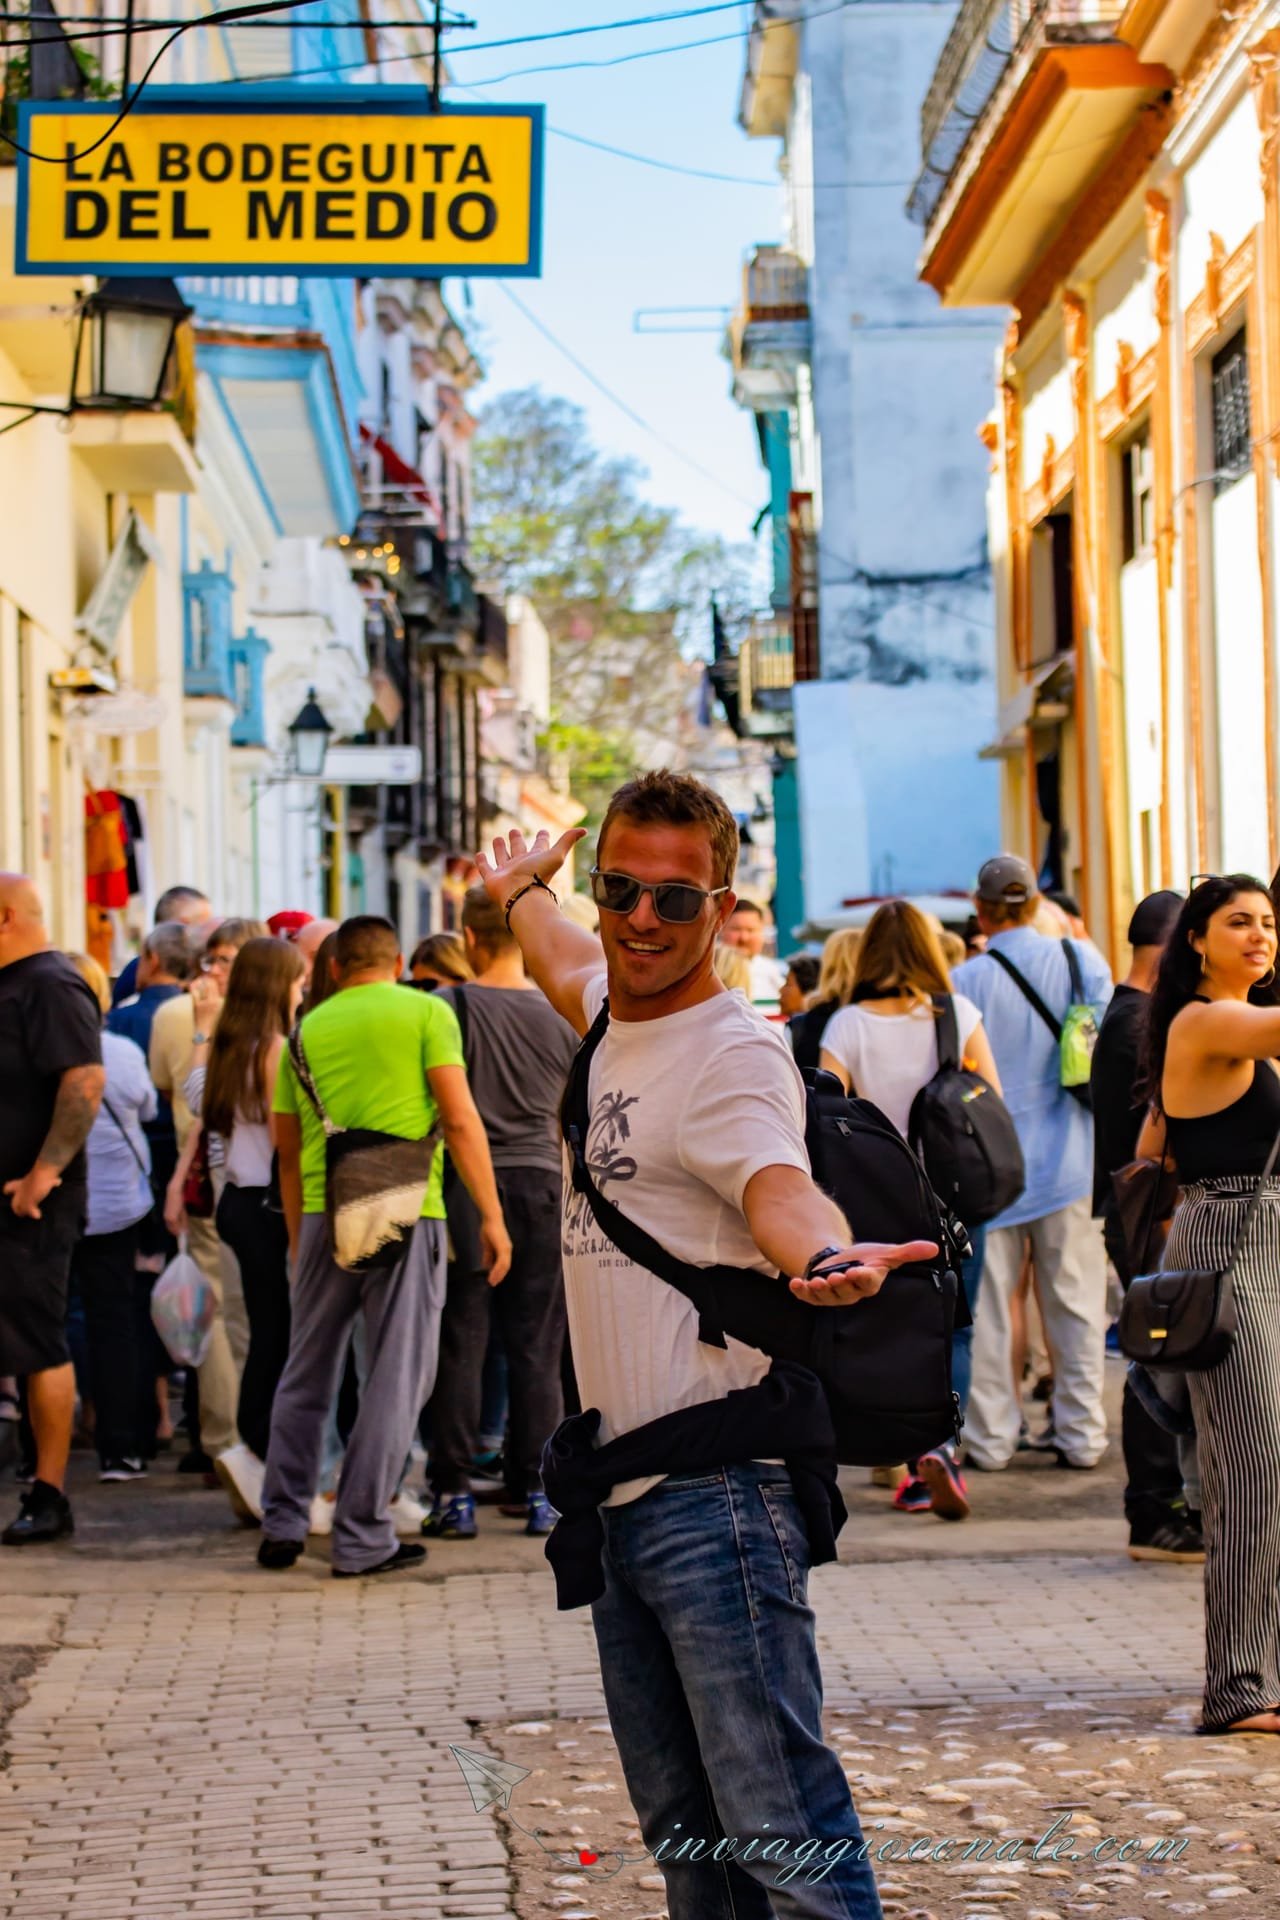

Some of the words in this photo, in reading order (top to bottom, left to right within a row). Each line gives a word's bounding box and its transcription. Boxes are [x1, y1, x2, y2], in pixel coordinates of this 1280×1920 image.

[65, 142, 134, 182] LA
[158, 143, 492, 184] BODEGUITA
[64, 190, 210, 239] DEL
[247, 190, 498, 242] MEDIO
